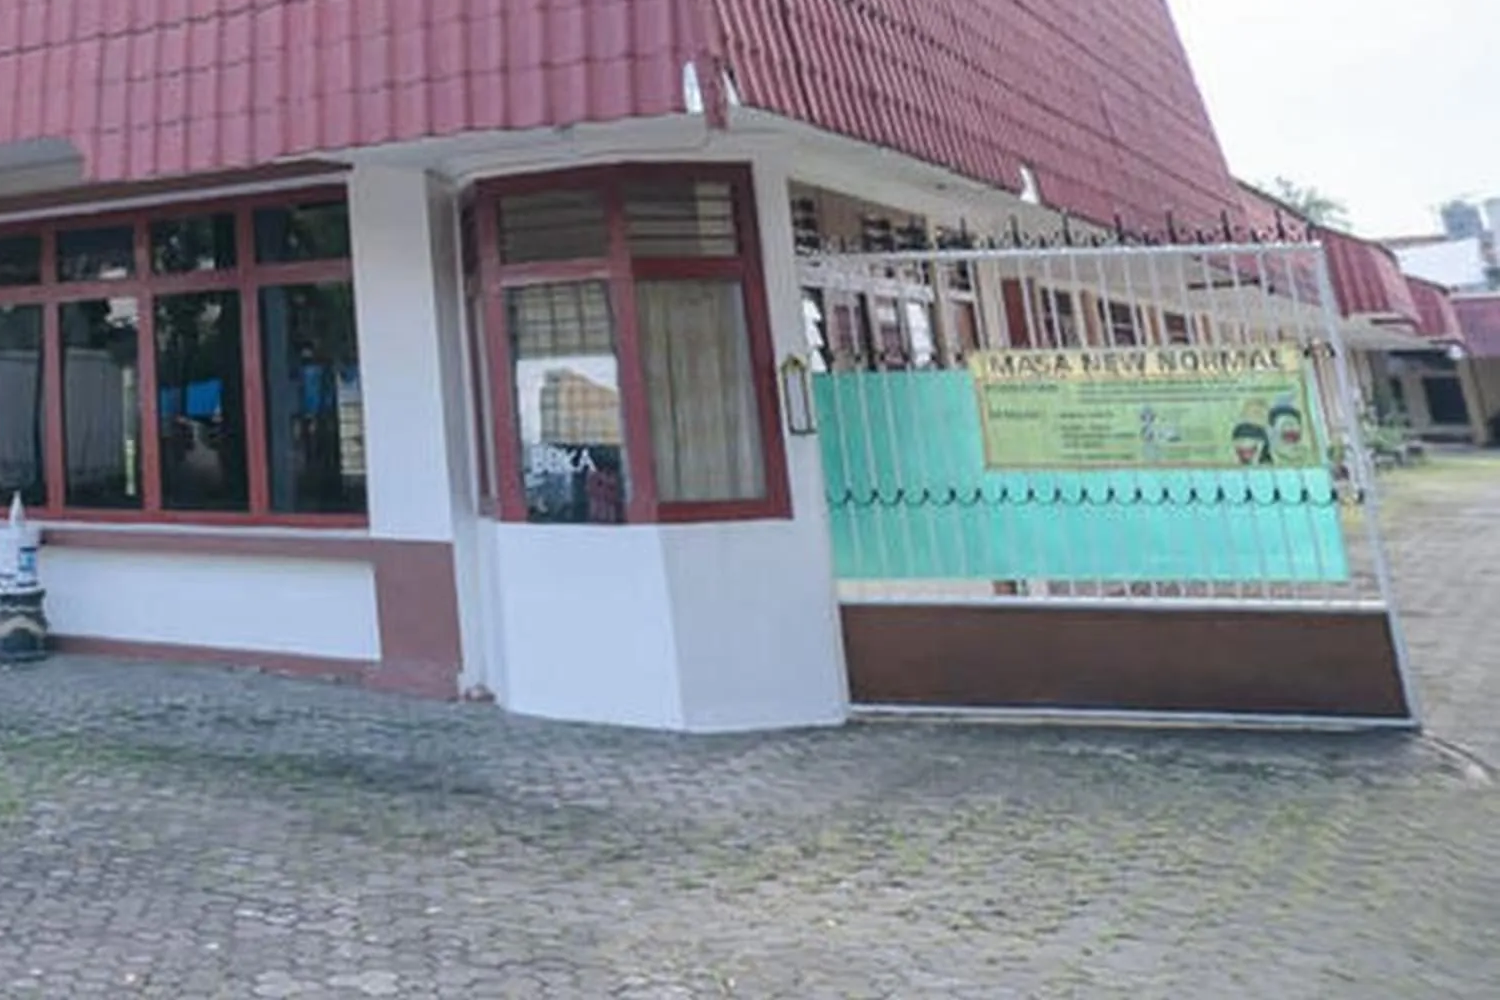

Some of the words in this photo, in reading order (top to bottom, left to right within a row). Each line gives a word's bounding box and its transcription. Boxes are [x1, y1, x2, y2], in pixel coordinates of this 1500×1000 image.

[988, 353, 1073, 376] MASA
[1082, 352, 1147, 375] NEW
[1157, 349, 1285, 374] NORMAL
